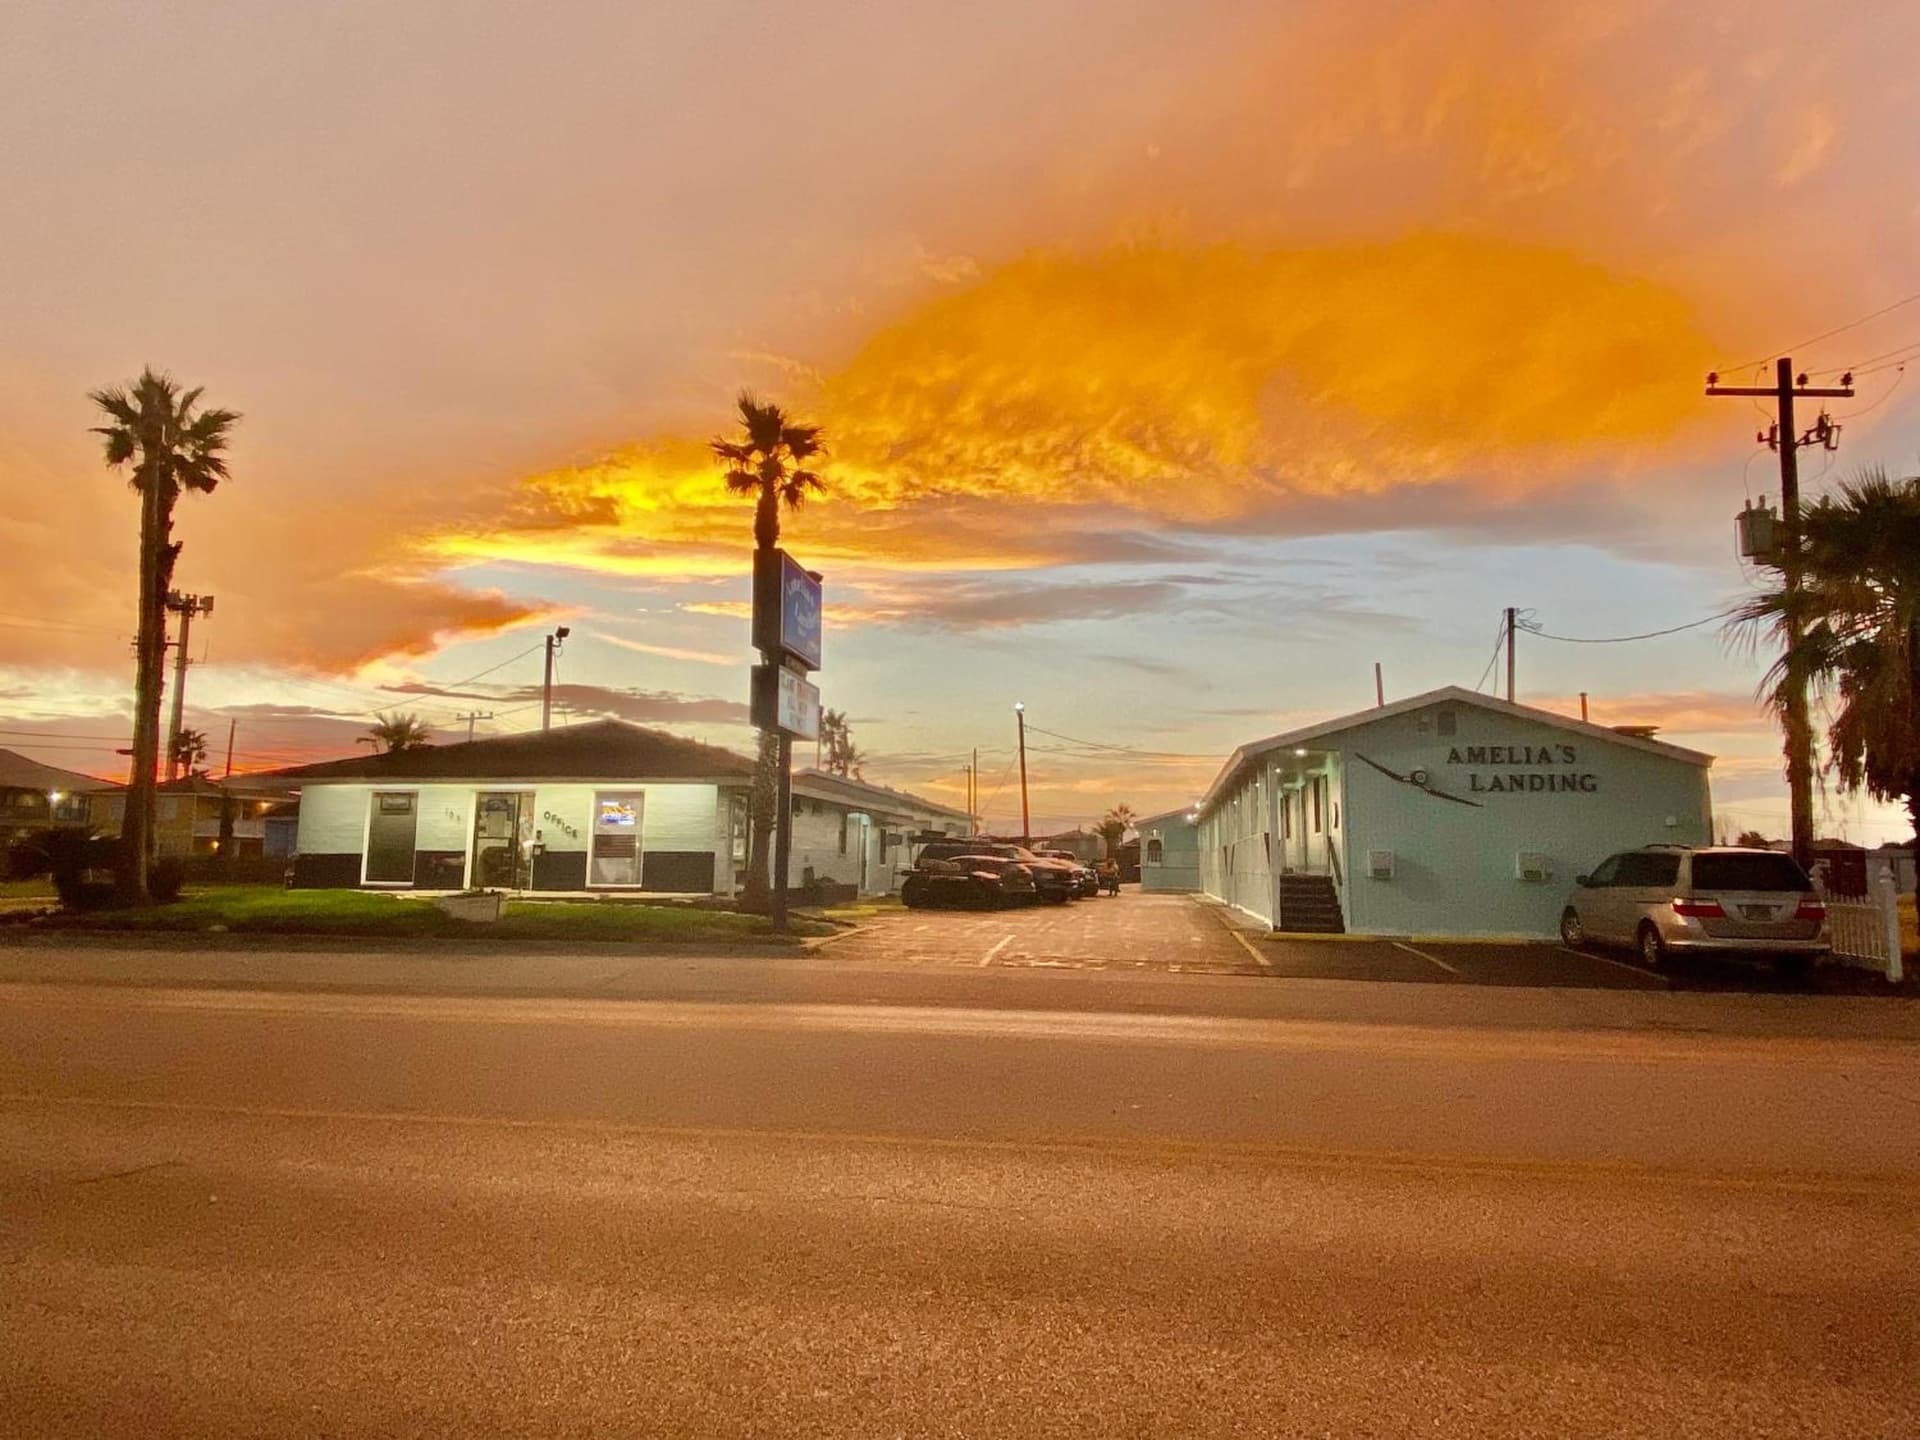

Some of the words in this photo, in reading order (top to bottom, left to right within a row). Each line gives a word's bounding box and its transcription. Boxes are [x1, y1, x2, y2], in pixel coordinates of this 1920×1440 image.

[1447, 744, 1577, 765] AMELIA'S
[1470, 773, 1598, 793] LANDING
[543, 810, 578, 840] OFFICE
